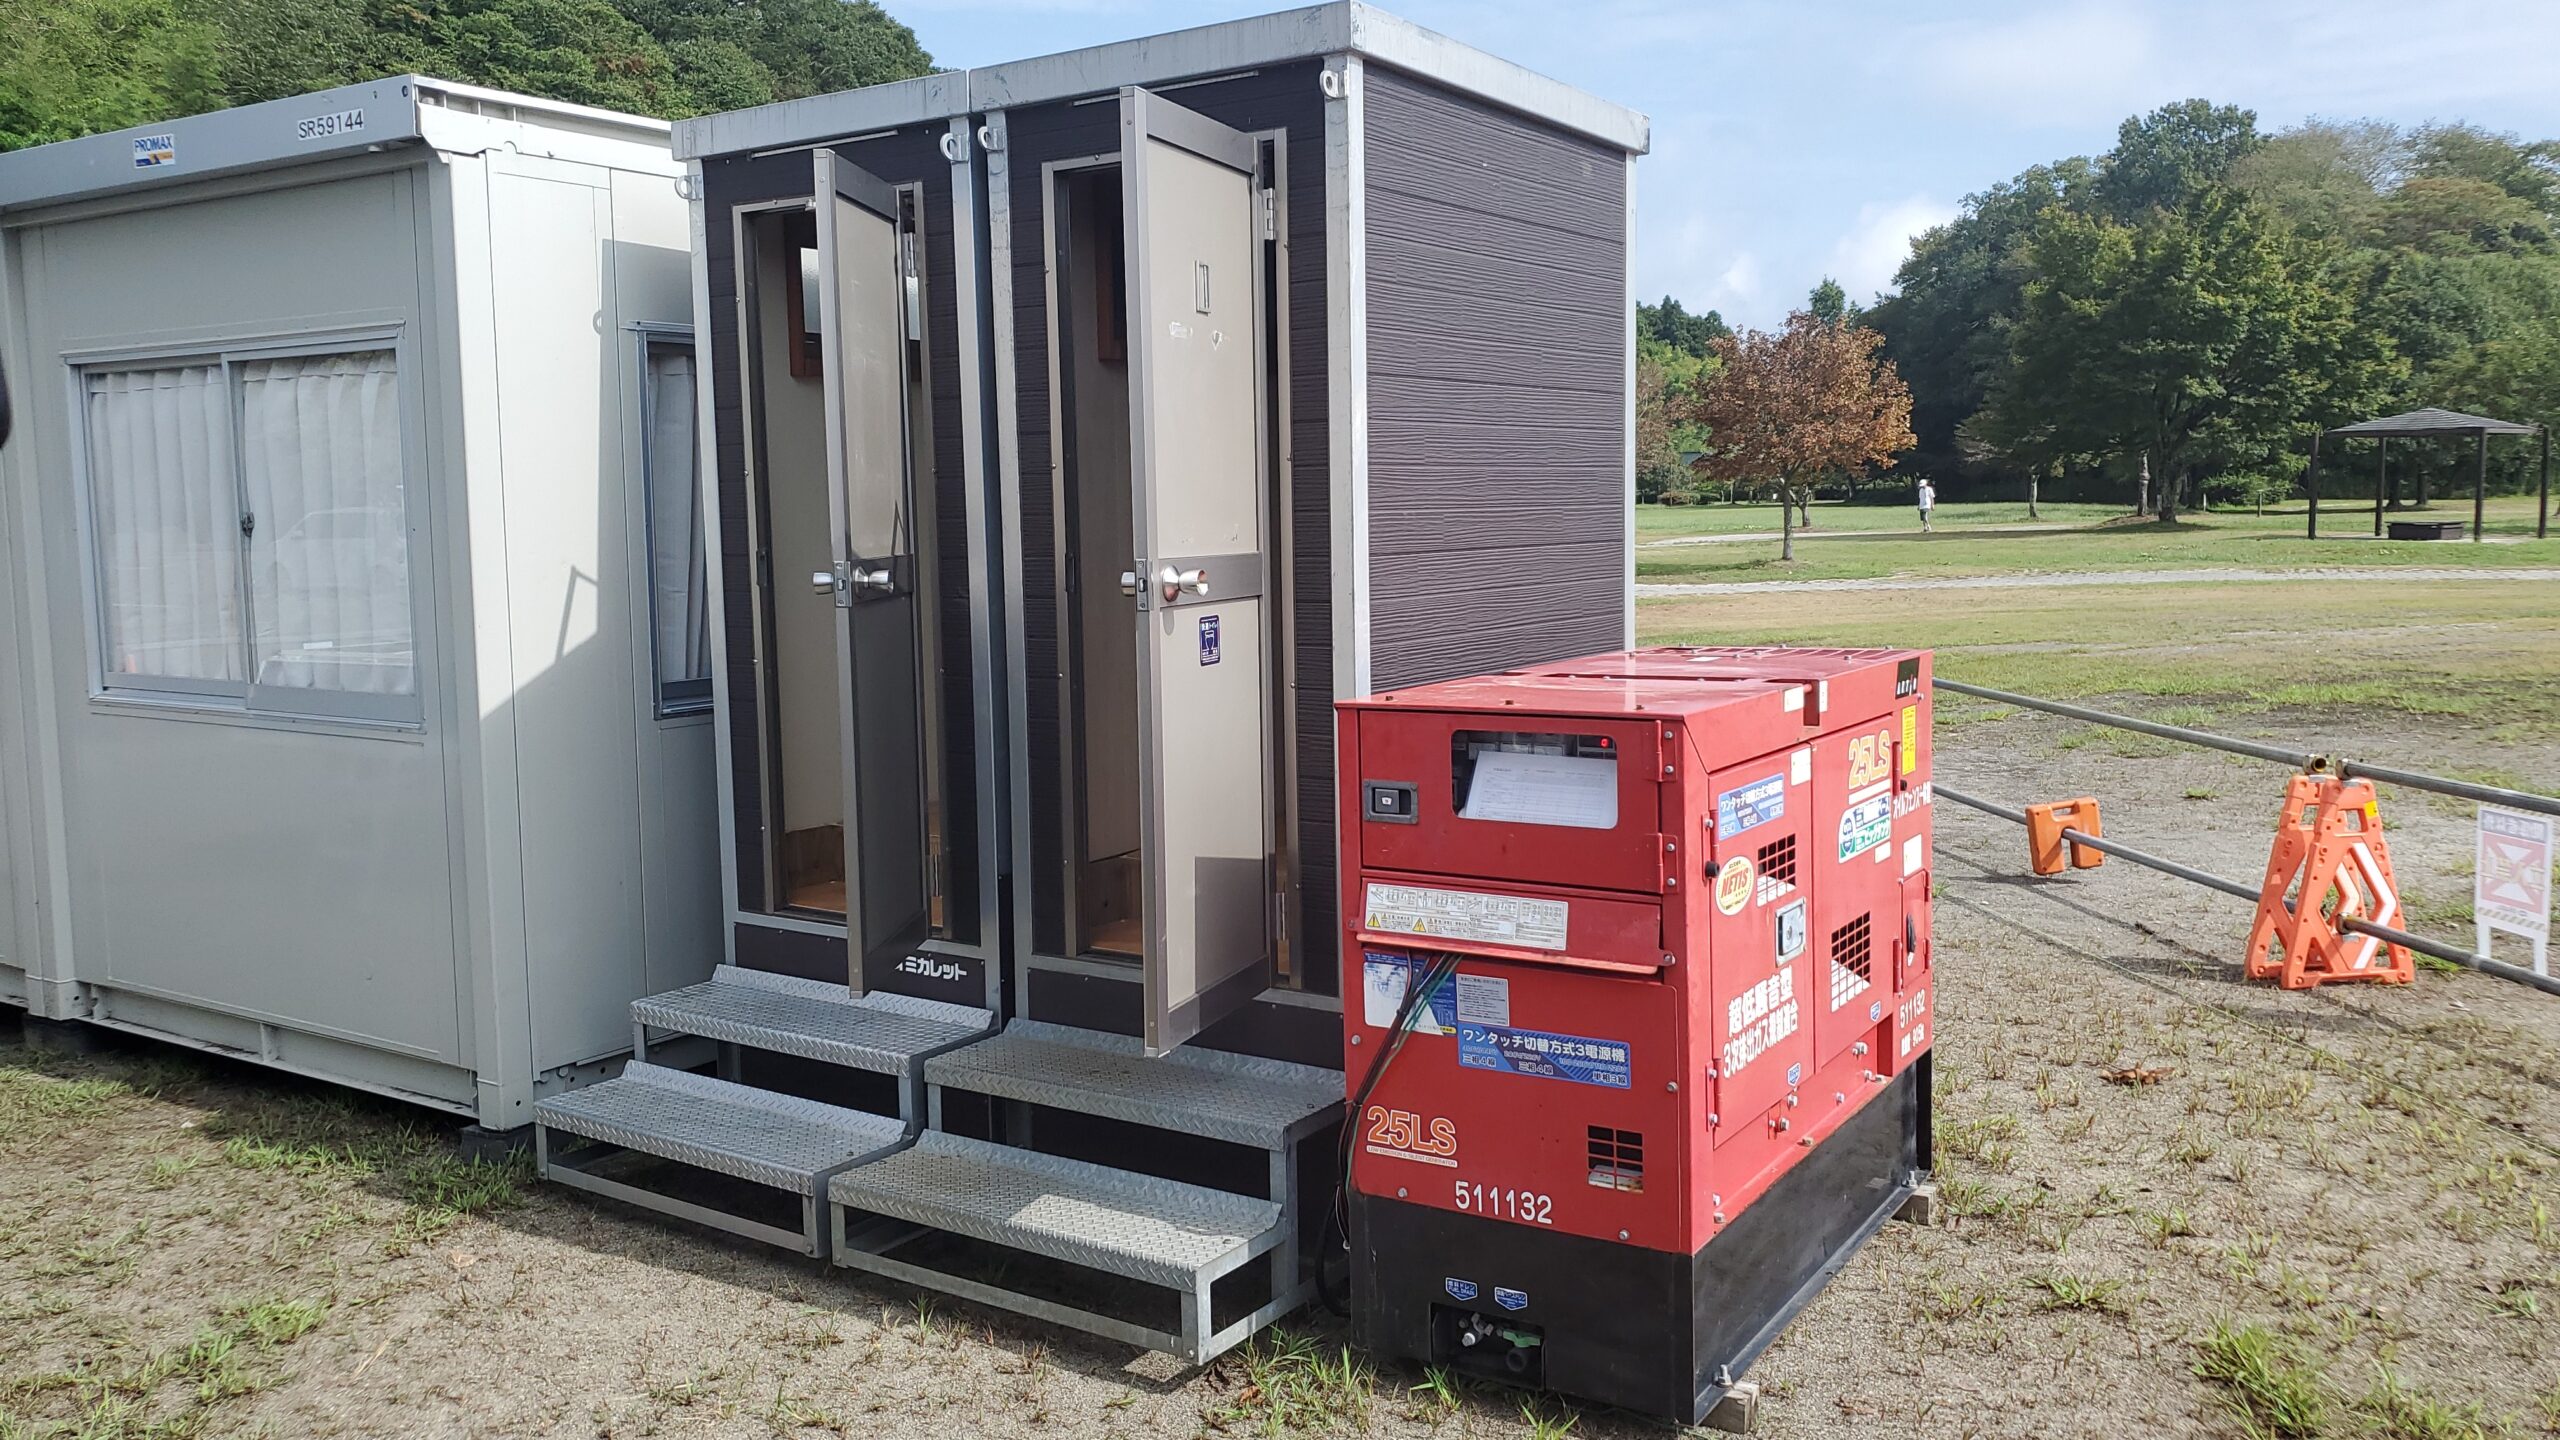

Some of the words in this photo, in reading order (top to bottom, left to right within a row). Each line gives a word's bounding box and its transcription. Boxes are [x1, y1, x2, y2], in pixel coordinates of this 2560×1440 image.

[134, 135, 173, 153] PROMAX
[299, 110, 364, 139] SR59144
[1848, 729, 1891, 790] 25LS
[1720, 867, 1749, 899] NETIS
[1900, 988, 1926, 1029] 511132
[1367, 1105, 1457, 1156] 25LS
[1455, 1180, 1553, 1225] 511132
